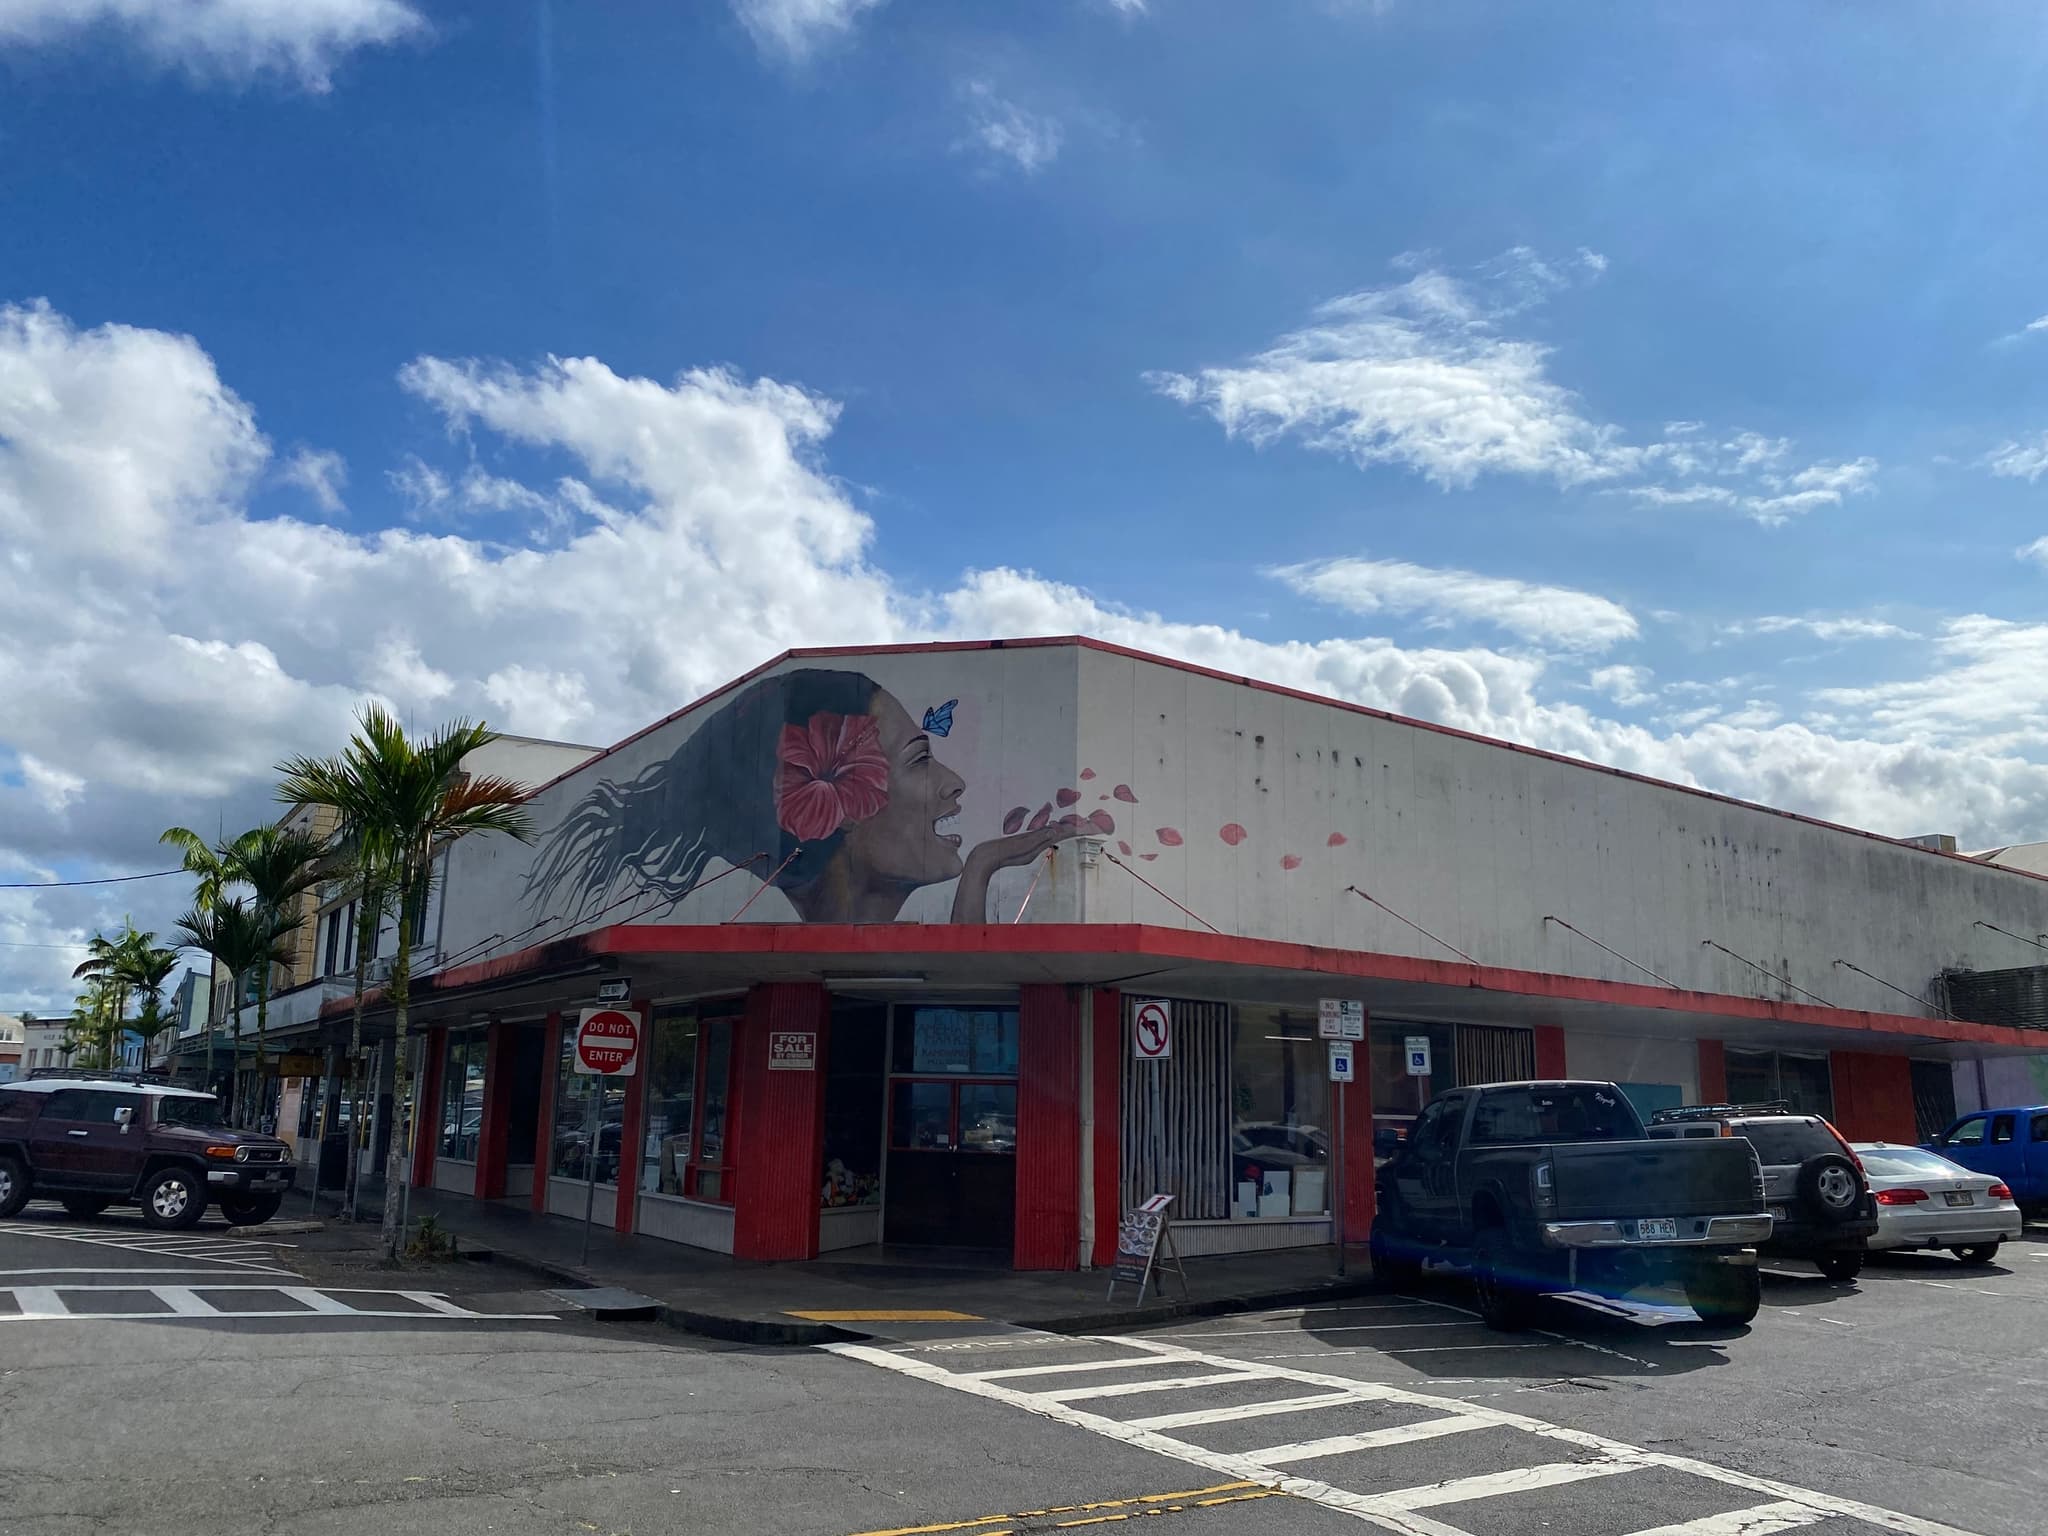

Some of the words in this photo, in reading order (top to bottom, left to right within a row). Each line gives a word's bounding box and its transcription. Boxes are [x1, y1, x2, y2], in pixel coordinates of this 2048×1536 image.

[1325, 1002, 1335, 1010] NO
[1342, 1002, 1348, 1013] 2
[589, 1022, 604, 1033] DO
[609, 1023, 632, 1035] NOT
[779, 1035, 807, 1044] FOR
[774, 1043, 812, 1053] SALE
[589, 1050, 623, 1063] ENTER
